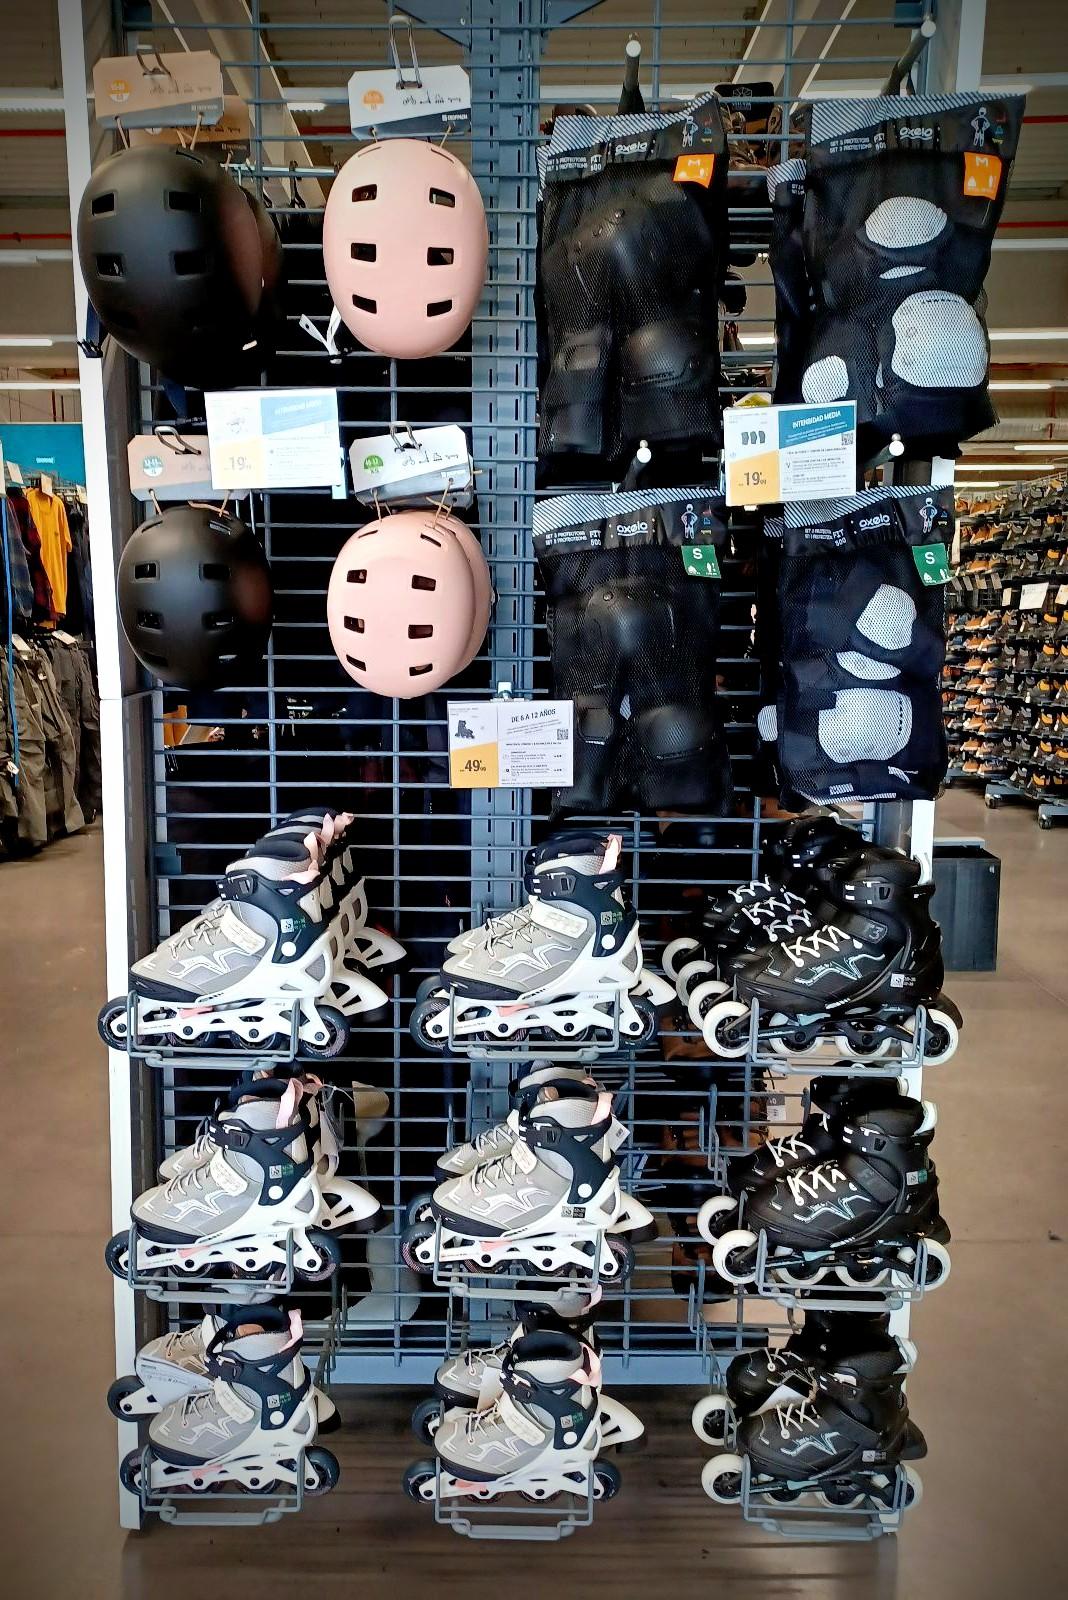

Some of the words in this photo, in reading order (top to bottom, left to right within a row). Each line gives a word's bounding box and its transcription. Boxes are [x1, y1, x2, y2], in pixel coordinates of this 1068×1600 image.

[900, 127, 933, 138] oxelo
[616, 141, 648, 153] oxelo
[688, 159, 701, 167] M
[975, 156, 989, 167] M
[792, 414, 823, 429] INTENSIDAD
[823, 410, 842, 420] MEDIA
[859, 513, 890, 528] oxelo
[616, 521, 648, 533] oxelo
[692, 548, 703, 560] S
[924, 551, 936, 565] S
[511, 715, 520, 723] DE
[531, 711, 539, 719] 12
[539, 708, 556, 718] AÑOS
